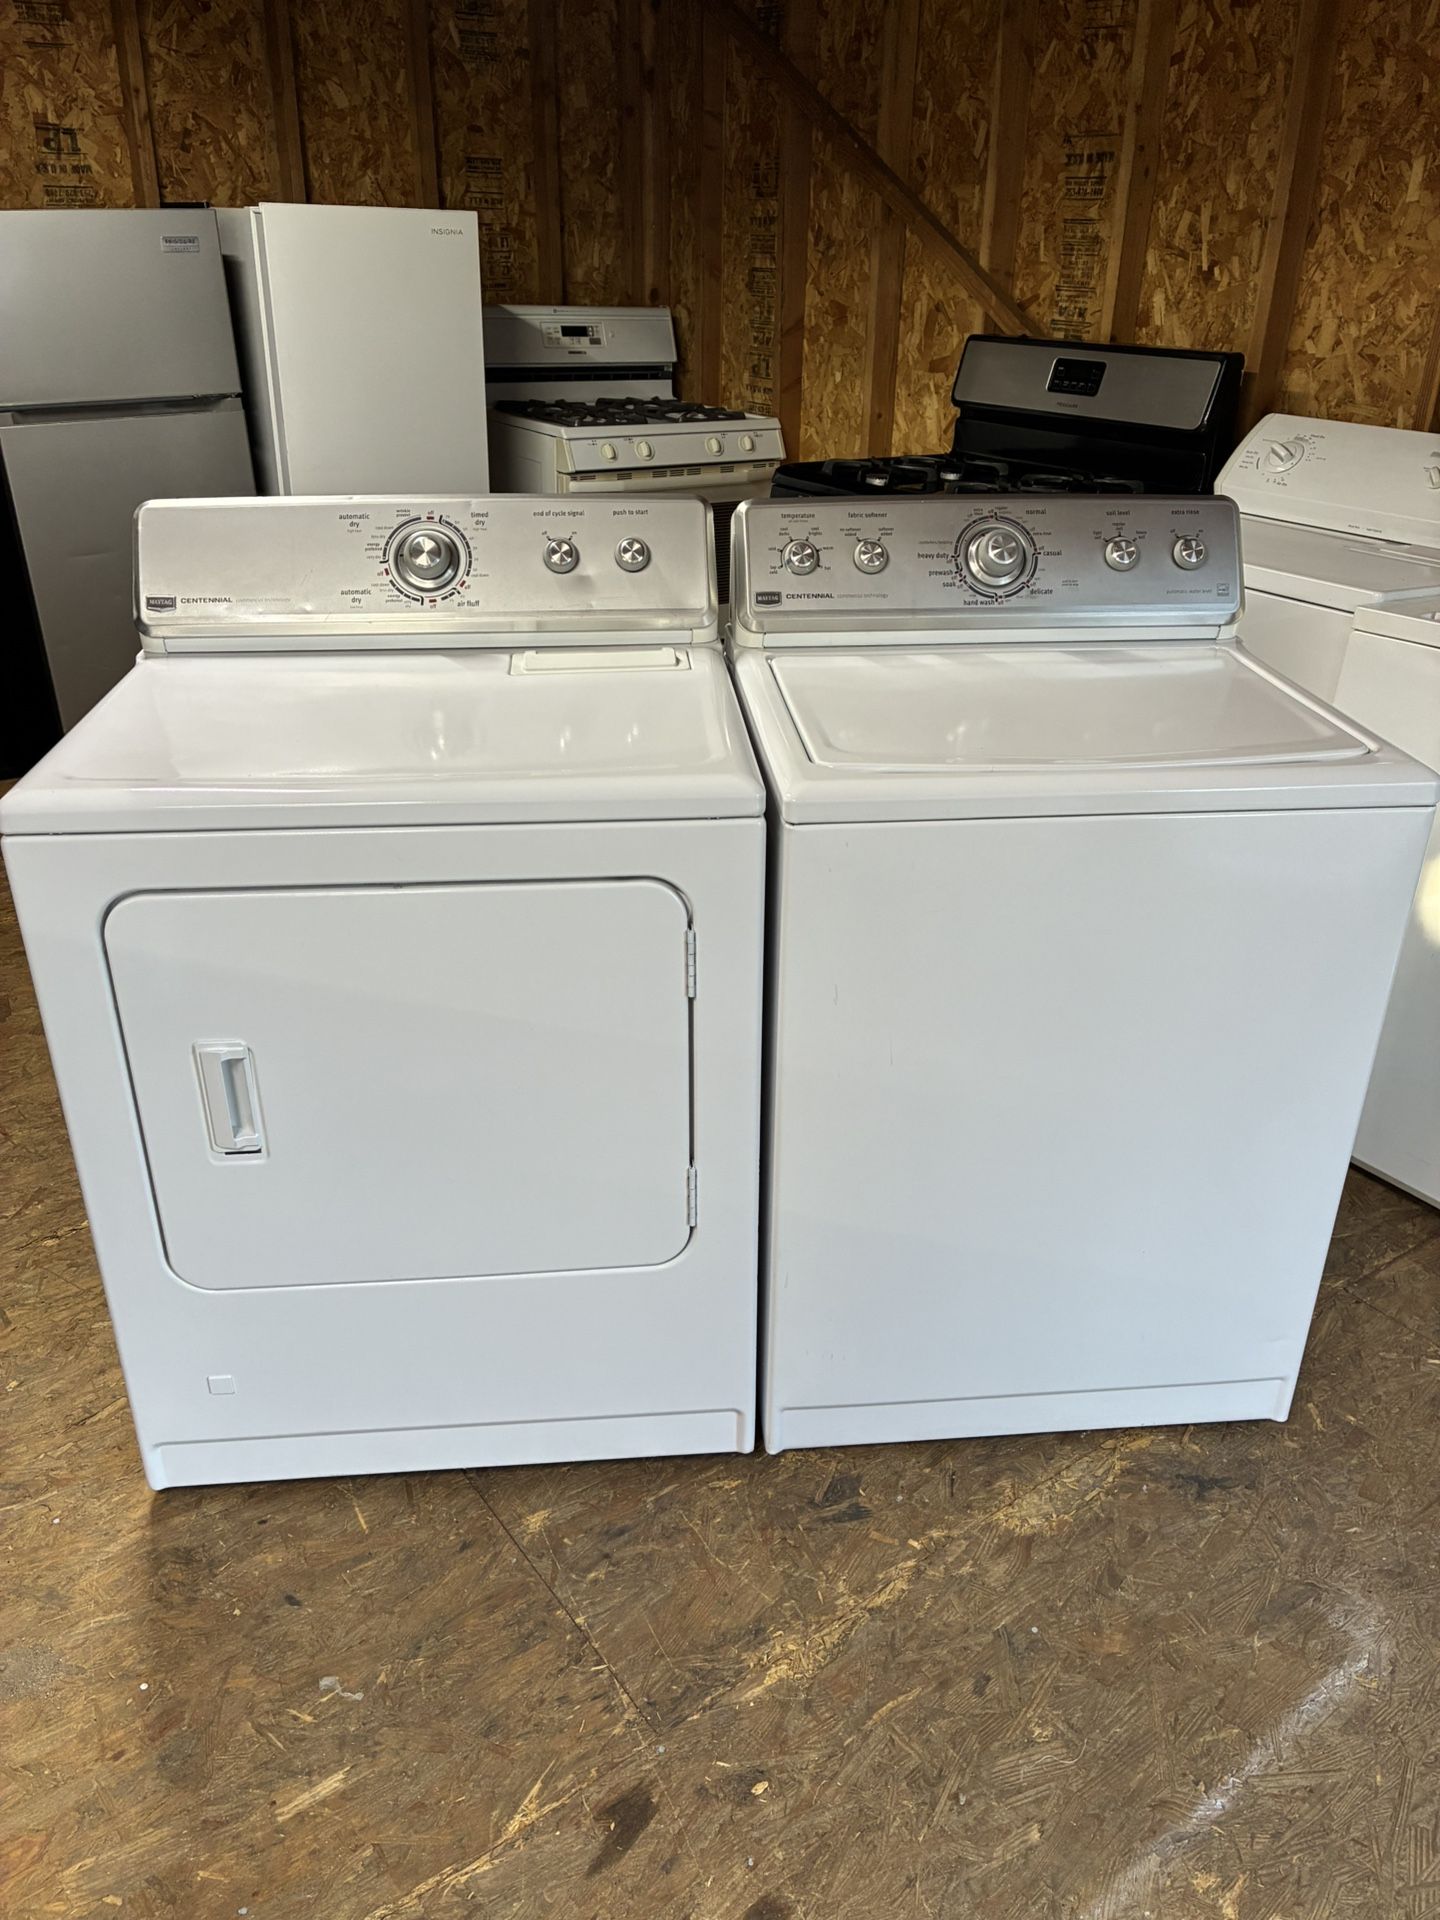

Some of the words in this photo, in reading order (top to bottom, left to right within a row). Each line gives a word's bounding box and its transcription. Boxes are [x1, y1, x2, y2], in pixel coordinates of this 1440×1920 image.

[917, 552, 935, 560] heavy
[935, 552, 949, 560] duty
[928, 569, 954, 577] prewash
[351, 596, 362, 604] dry
